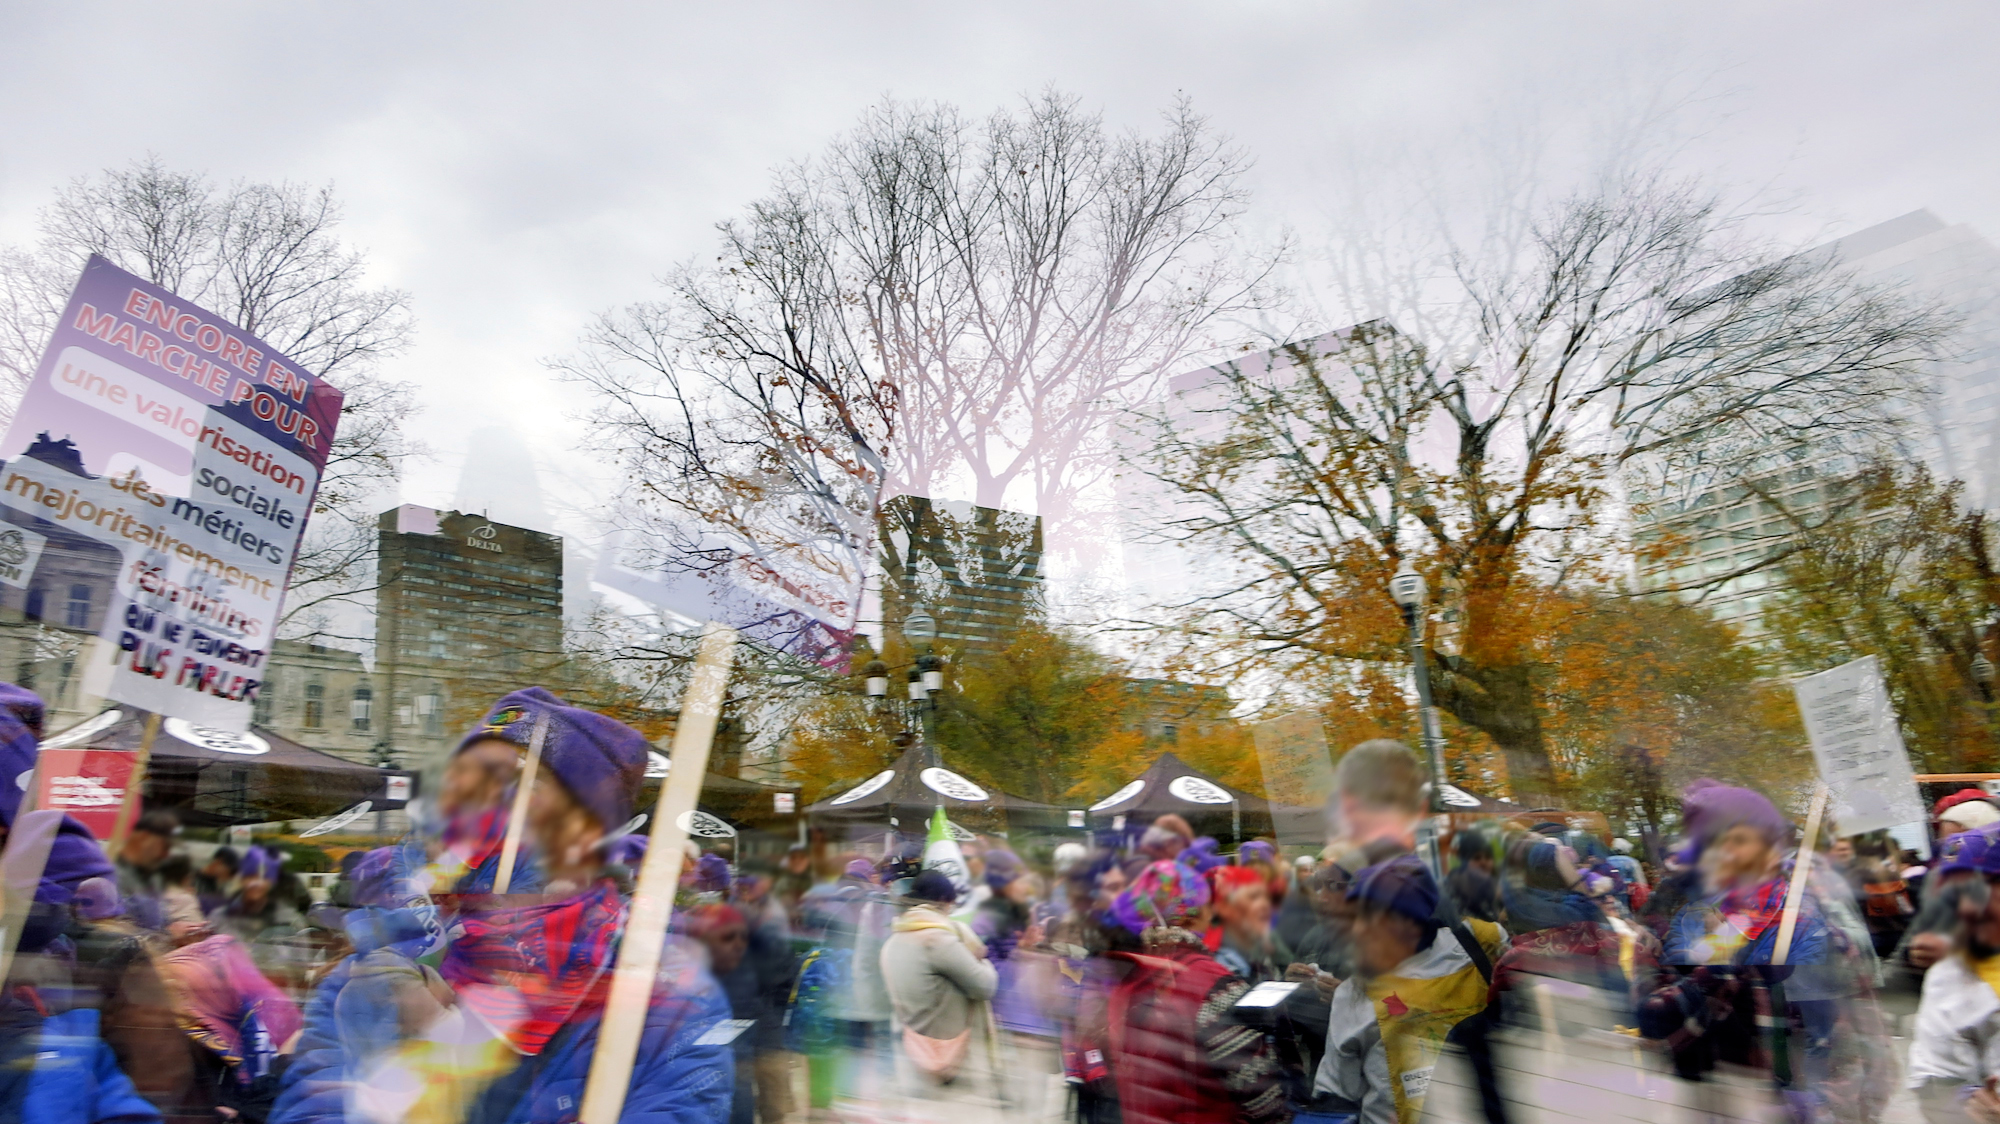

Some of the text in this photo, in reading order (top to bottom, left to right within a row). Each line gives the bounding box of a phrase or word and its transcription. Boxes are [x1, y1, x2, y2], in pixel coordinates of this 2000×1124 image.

[73, 303, 320, 450] MARCHE POUR
[124, 288, 310, 404] ENCORE EN
[60, 361, 306, 495] une valorisation
[4, 471, 276, 601] majoritairement
[109, 468, 284, 565] des métiers
[196, 464, 296, 530] sociale
[467, 536, 503, 552] DELTA
[129, 560, 263, 638] féminins
